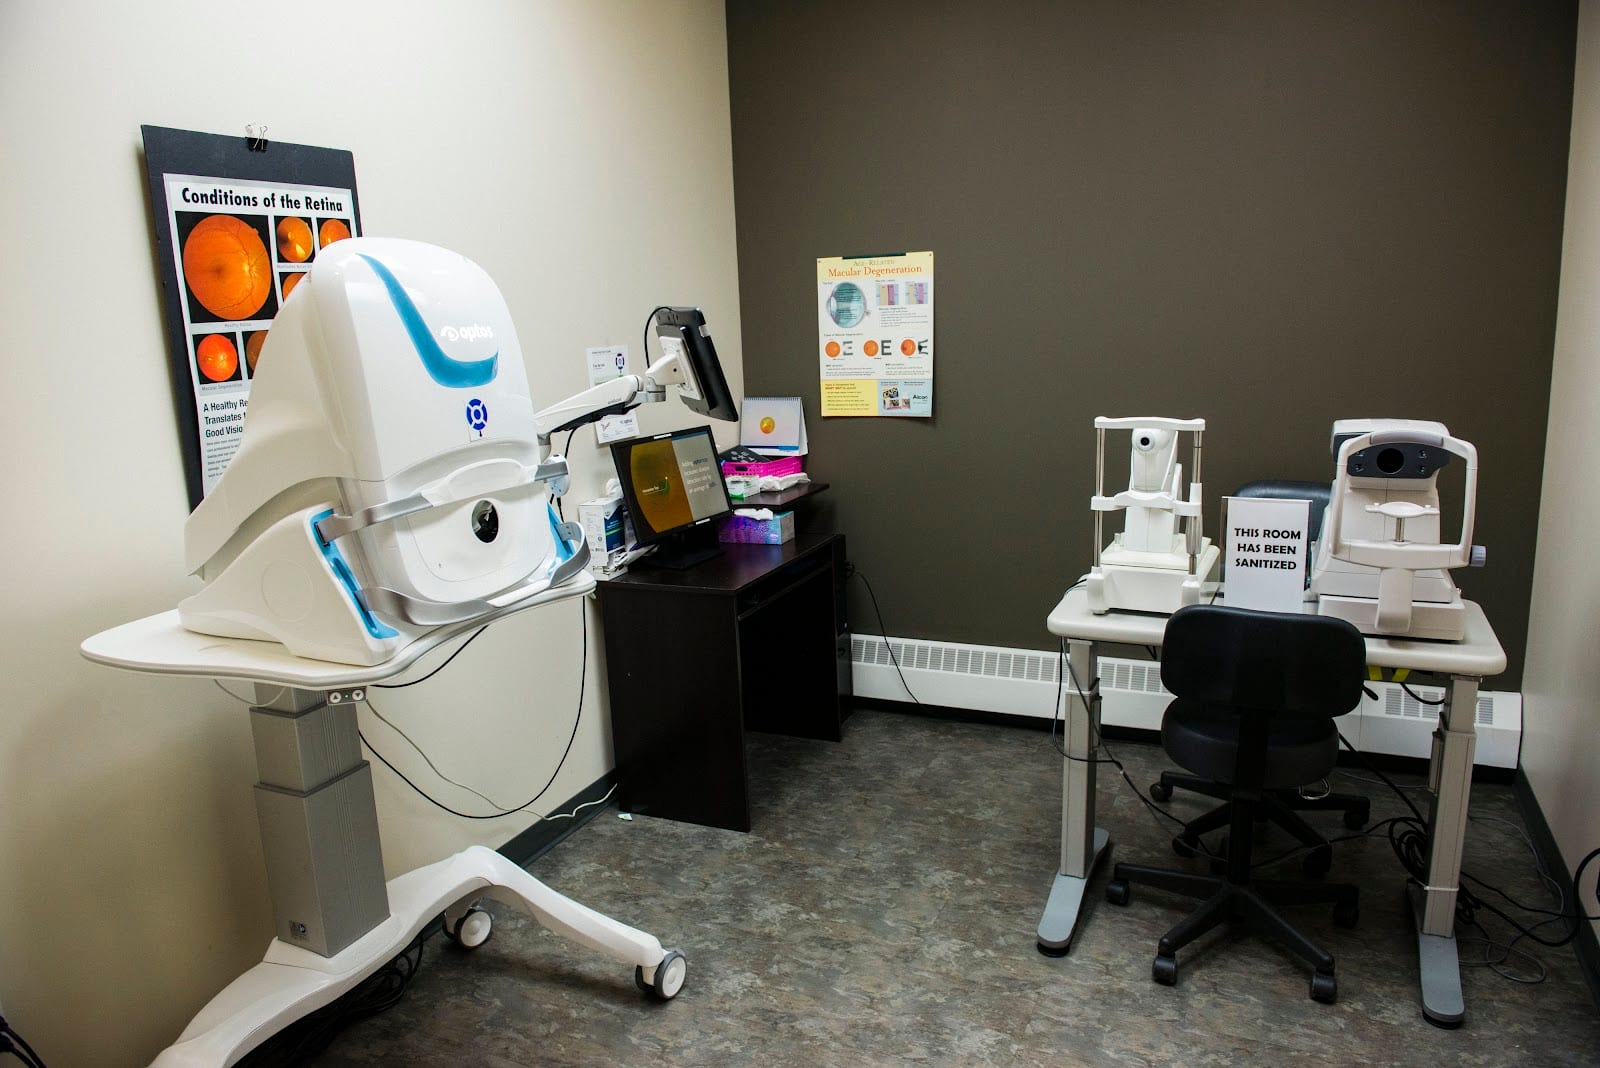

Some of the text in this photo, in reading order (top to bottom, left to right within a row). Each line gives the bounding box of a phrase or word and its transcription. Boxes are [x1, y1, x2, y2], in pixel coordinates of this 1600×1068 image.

[182, 187, 343, 212] Conditions of the Retina
[828, 266, 922, 277] Macular Degeneration
[460, 323, 493, 342] optos
[203, 403, 209, 413] A
[210, 400, 238, 411] Healthy
[204, 413, 242, 425] Translates
[205, 427, 225, 438] Good
[1234, 527, 1301, 540] THIS ROOM
[1237, 543, 1297, 555] HAS BEEN
[1235, 558, 1297, 570] SANITIZED
